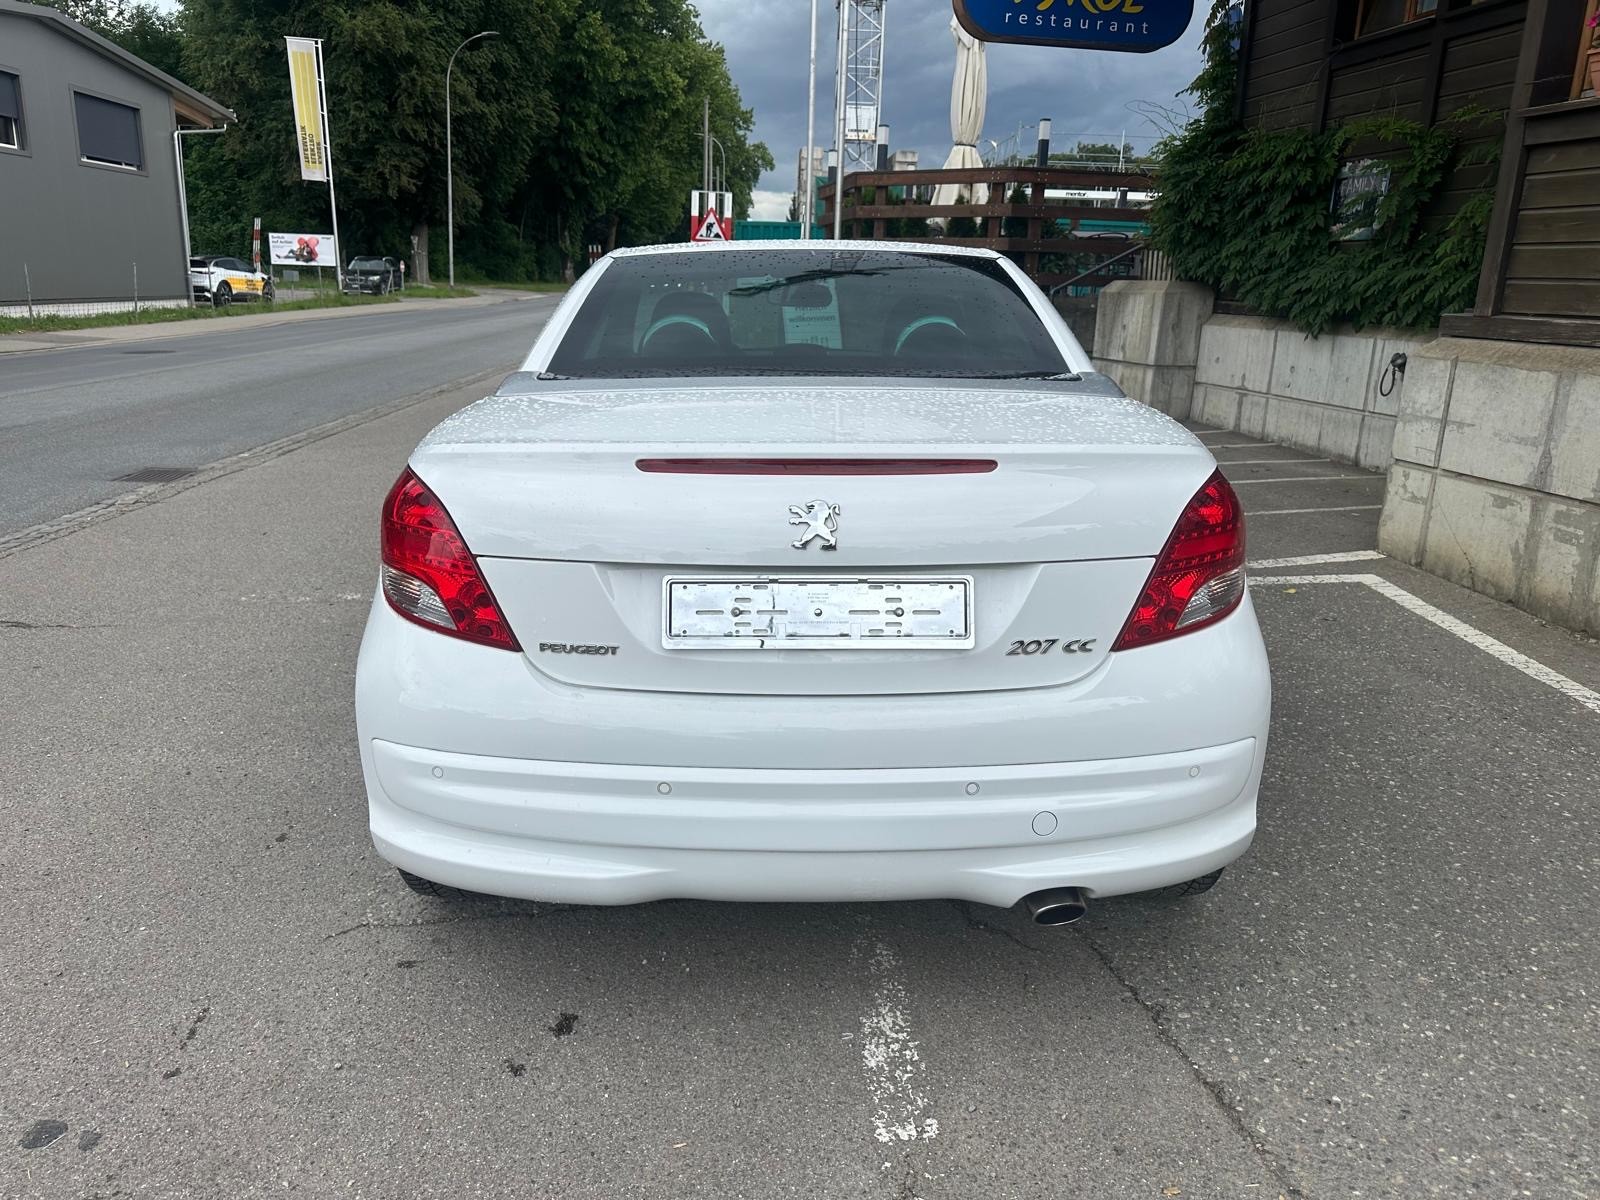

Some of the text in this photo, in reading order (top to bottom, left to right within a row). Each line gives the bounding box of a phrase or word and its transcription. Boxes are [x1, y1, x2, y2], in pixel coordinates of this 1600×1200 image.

[1004, 11, 1150, 34] restaurant
[539, 642, 620, 656] PEUGEOT
[1005, 638, 1097, 656] 207 CC
